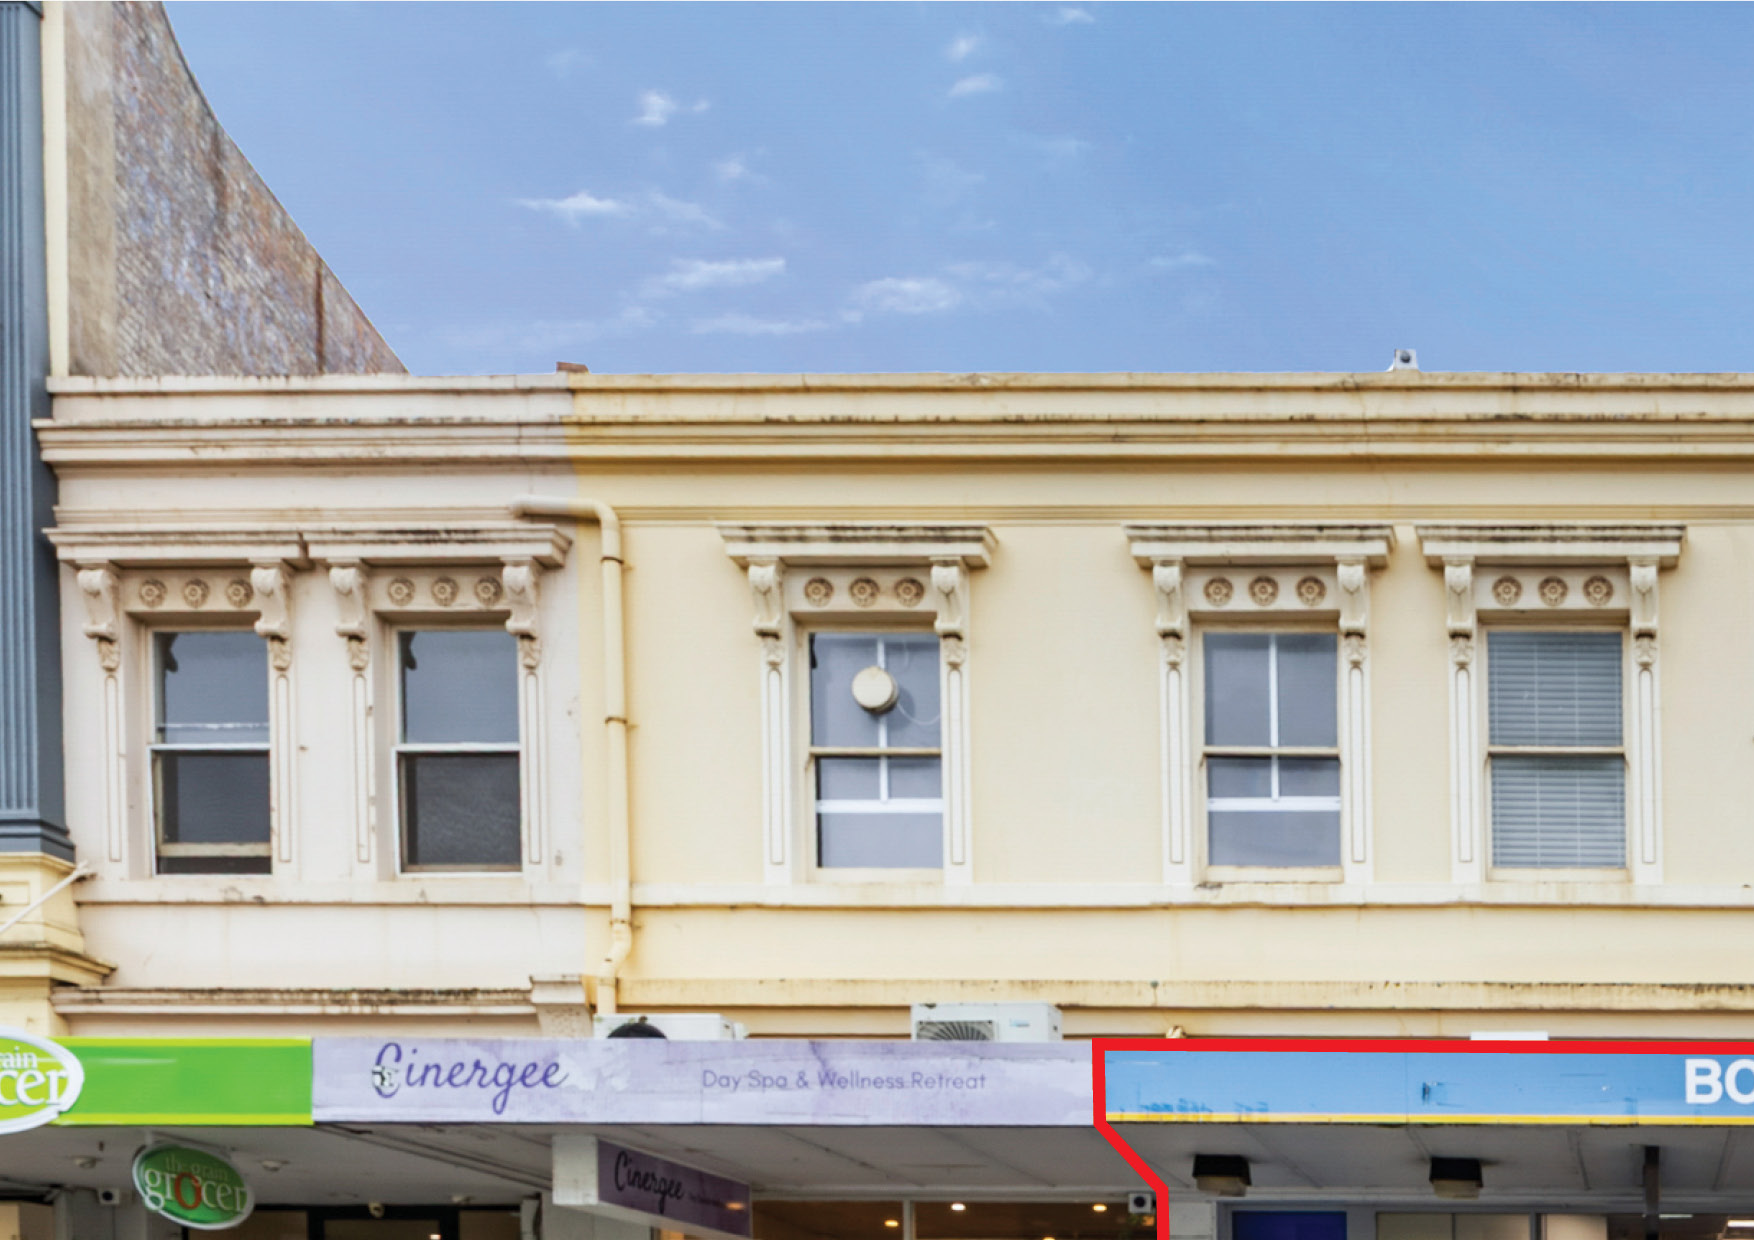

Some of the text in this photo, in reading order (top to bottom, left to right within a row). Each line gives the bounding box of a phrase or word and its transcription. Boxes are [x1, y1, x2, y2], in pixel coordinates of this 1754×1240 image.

[0, 1045, 38, 1069] ain
[372, 1042, 570, 1115] Cinergee
[702, 1070, 987, 1092] Day Spa & Wellness Retreat
[614, 1150, 684, 1215] Cinergee
